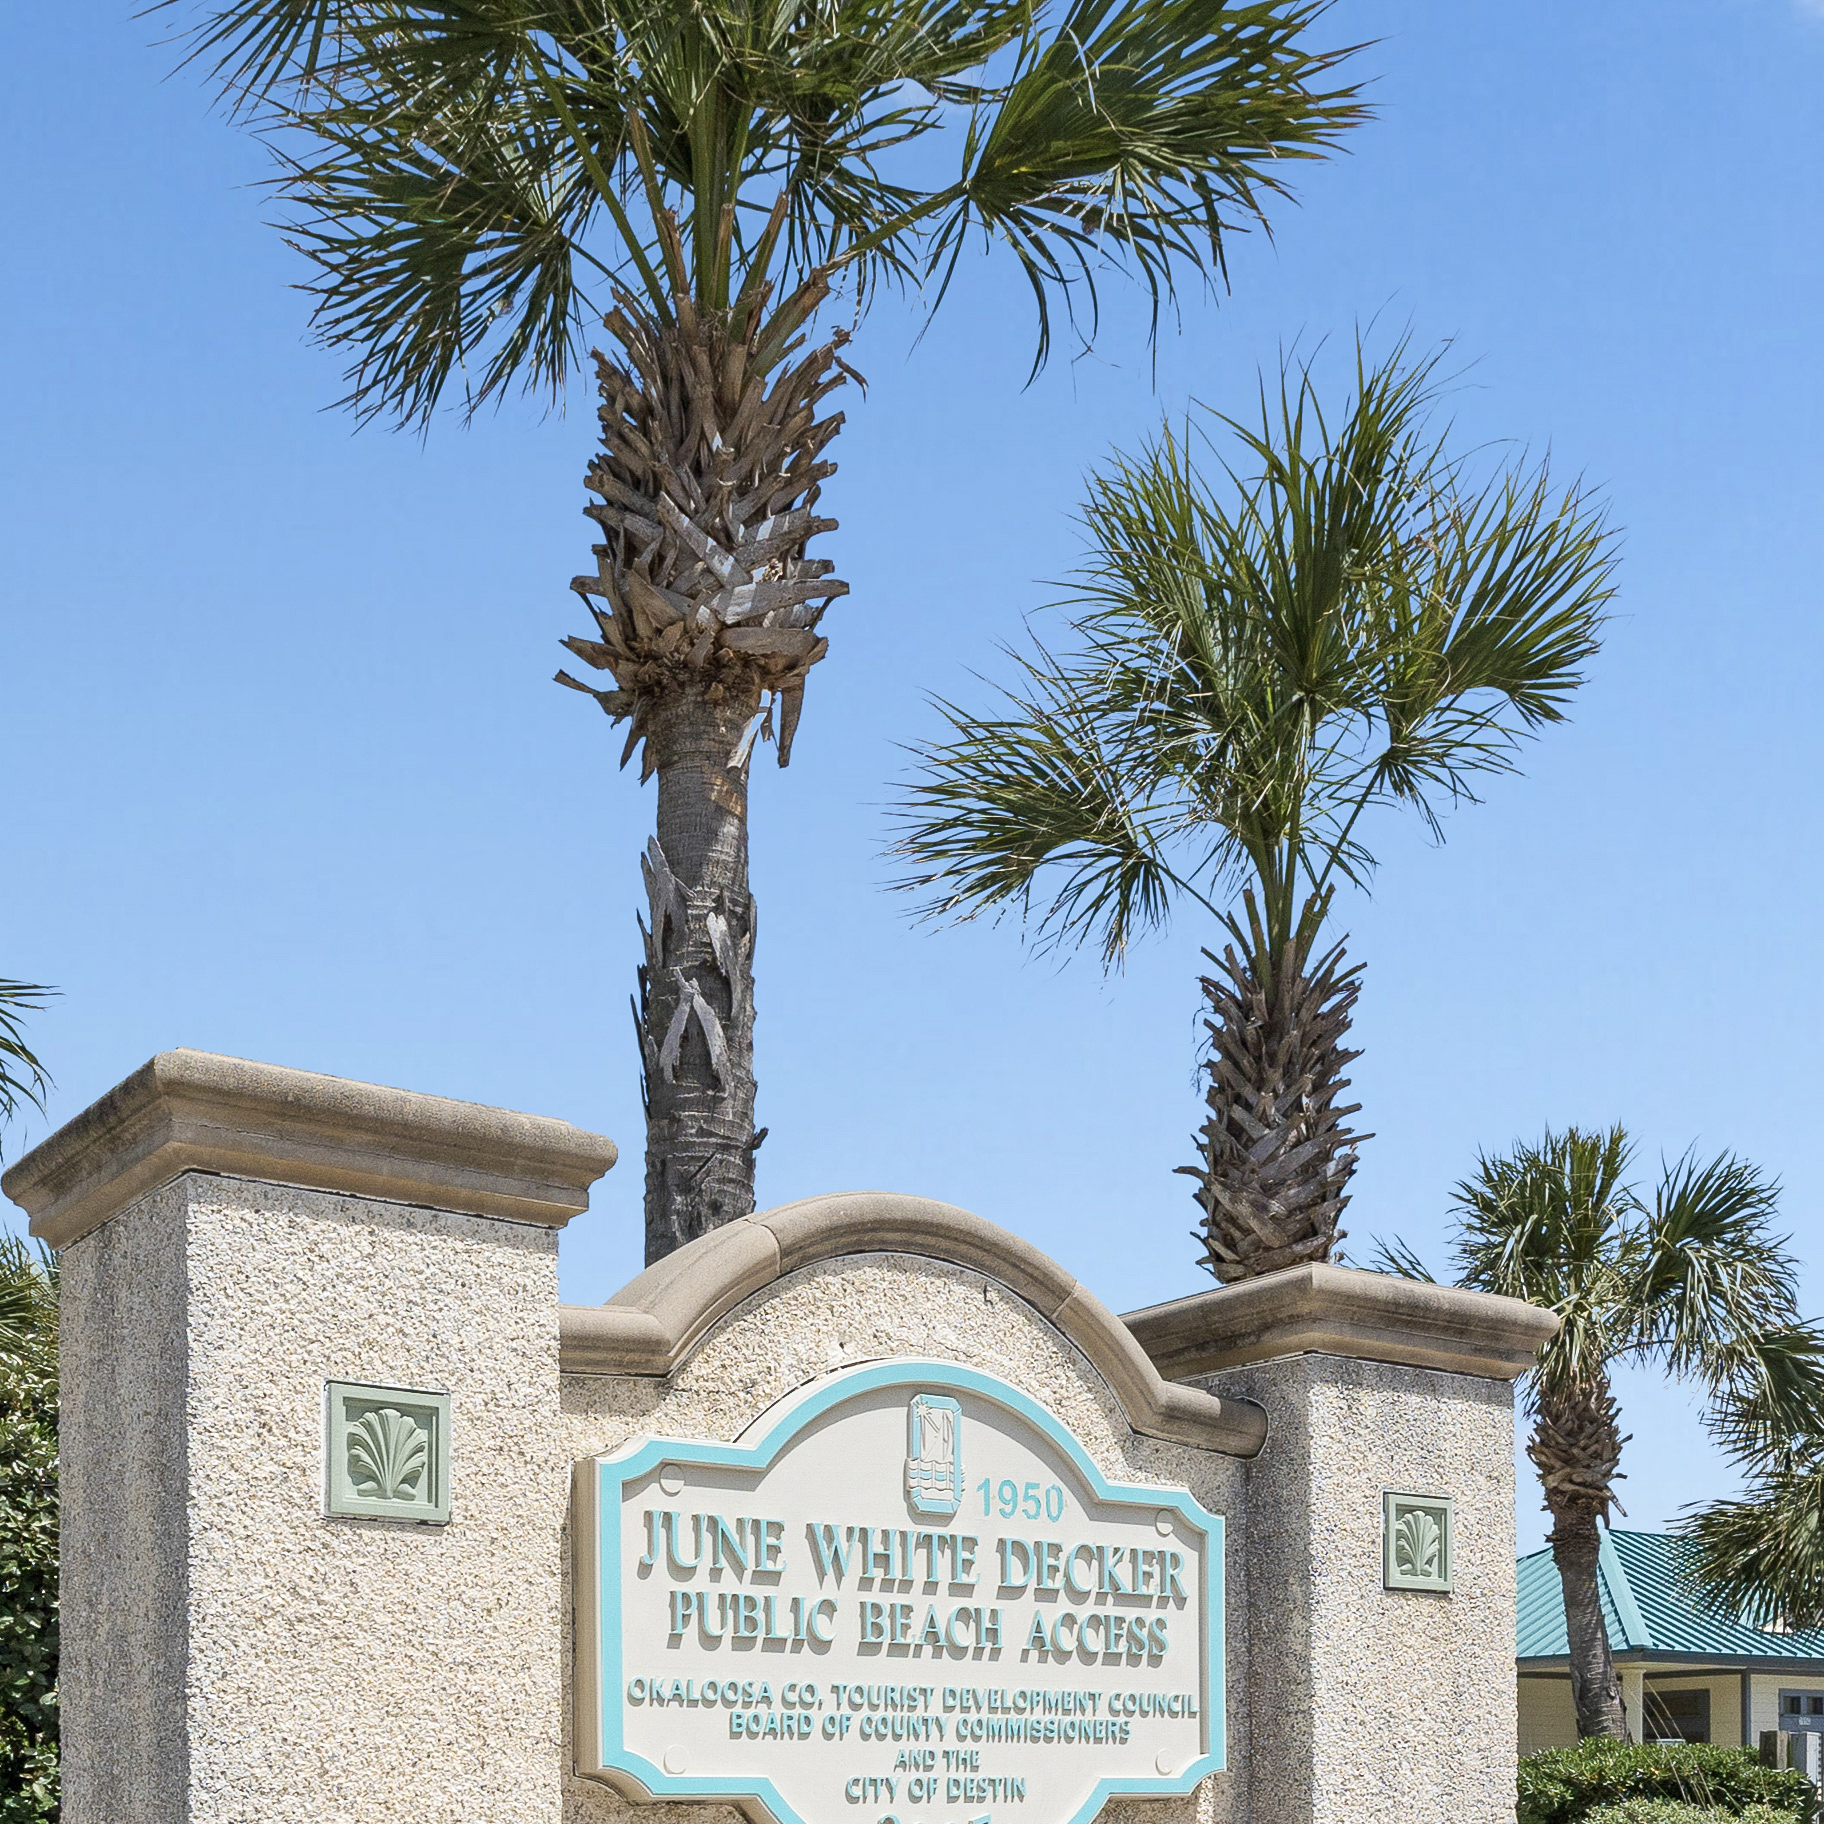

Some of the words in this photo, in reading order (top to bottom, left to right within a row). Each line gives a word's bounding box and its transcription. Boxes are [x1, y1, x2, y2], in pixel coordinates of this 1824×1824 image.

[976, 1477, 1064, 1522] 1950
[640, 1510, 788, 1573] JUNE
[806, 1522, 981, 1586] WHITE
[998, 1537, 1189, 1598] DECKER
[669, 1590, 838, 1642] PUBLIC
[859, 1601, 1005, 1649] BEACH
[1026, 1610, 1170, 1656] ACCESS
[628, 1676, 774, 1703] OKALOOSA
[831, 1683, 934, 1707] TOURIST
[943, 1686, 1103, 1711] DEVELOPMENT
[1108, 1692, 1200, 1715] COUNCIL
[730, 1711, 815, 1736] BOARD
[823, 1712, 853, 1736] OF
[860, 1713, 950, 1737] COUNTY
[956, 1716, 1131, 1741] COMMISSIONERS
[895, 1749, 938, 1768] AND
[942, 1749, 981, 1768] THE
[847, 1776, 901, 1799] CITY
[909, 1776, 939, 1799] OF
[946, 1776, 1026, 1799] DESTIN
